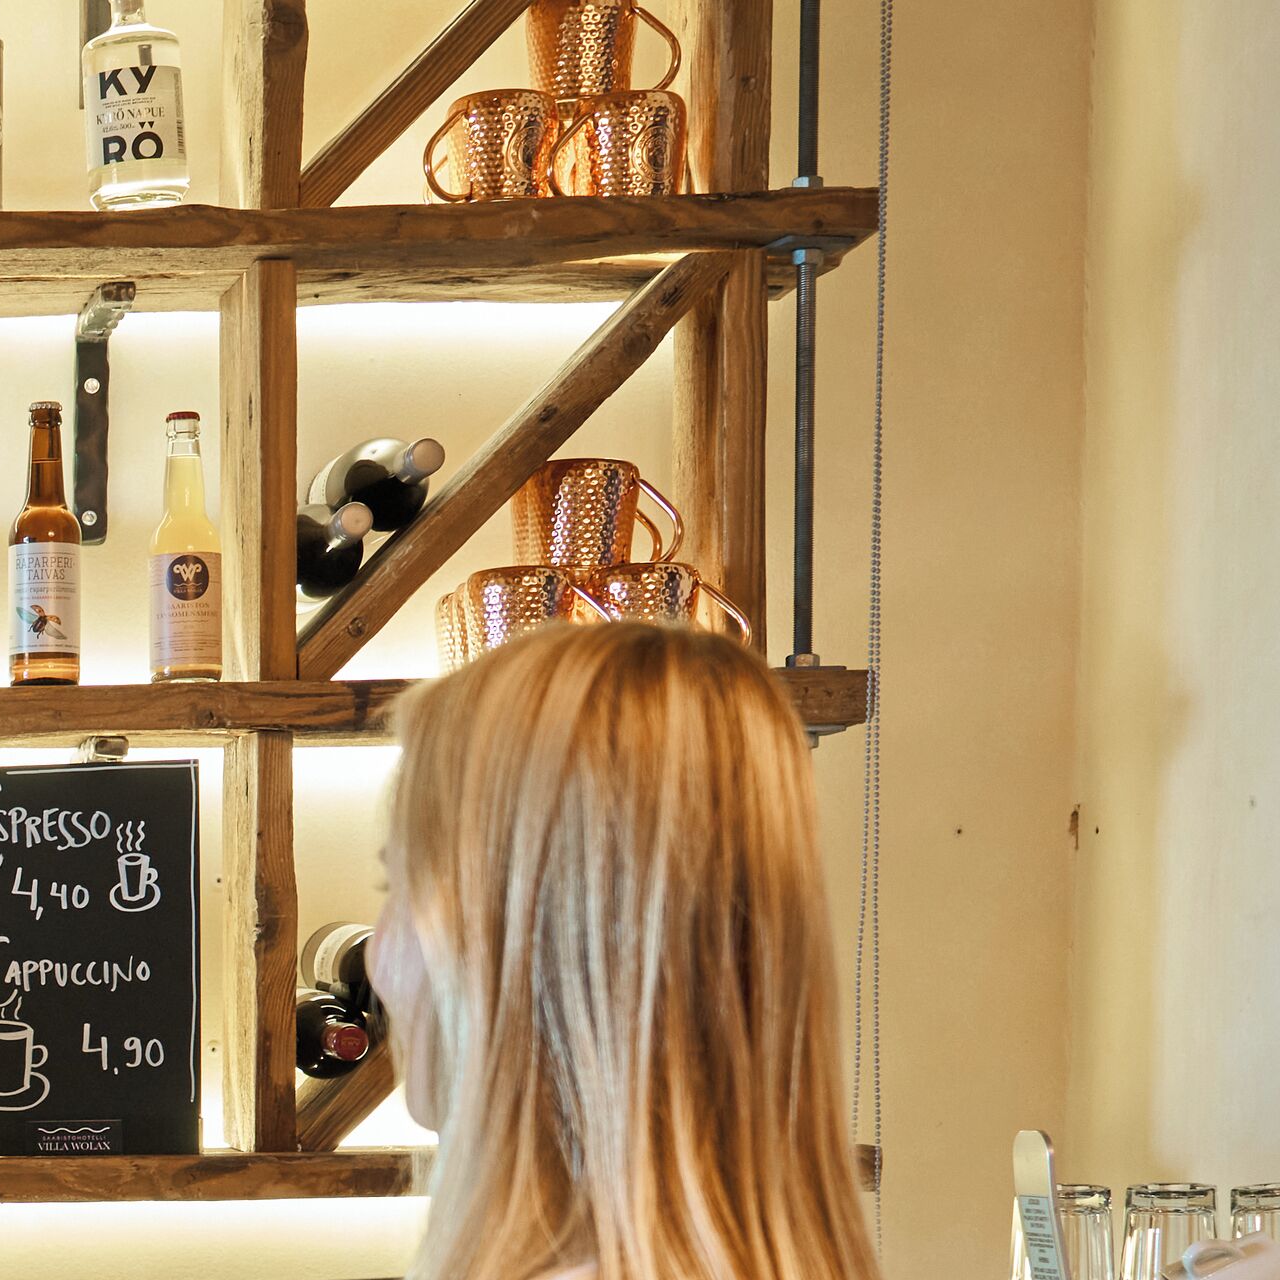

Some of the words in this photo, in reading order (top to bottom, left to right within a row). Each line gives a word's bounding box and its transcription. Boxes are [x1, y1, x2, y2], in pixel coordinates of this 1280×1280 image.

[98, 65, 157, 100] KY
[102, 121, 164, 165] RÖ
[27, 568, 65, 580] TAIVAS
[11, 866, 90, 921] 4,40
[38, 1141, 69, 1151] VILLA
[71, 1141, 111, 1151] WOLAX
